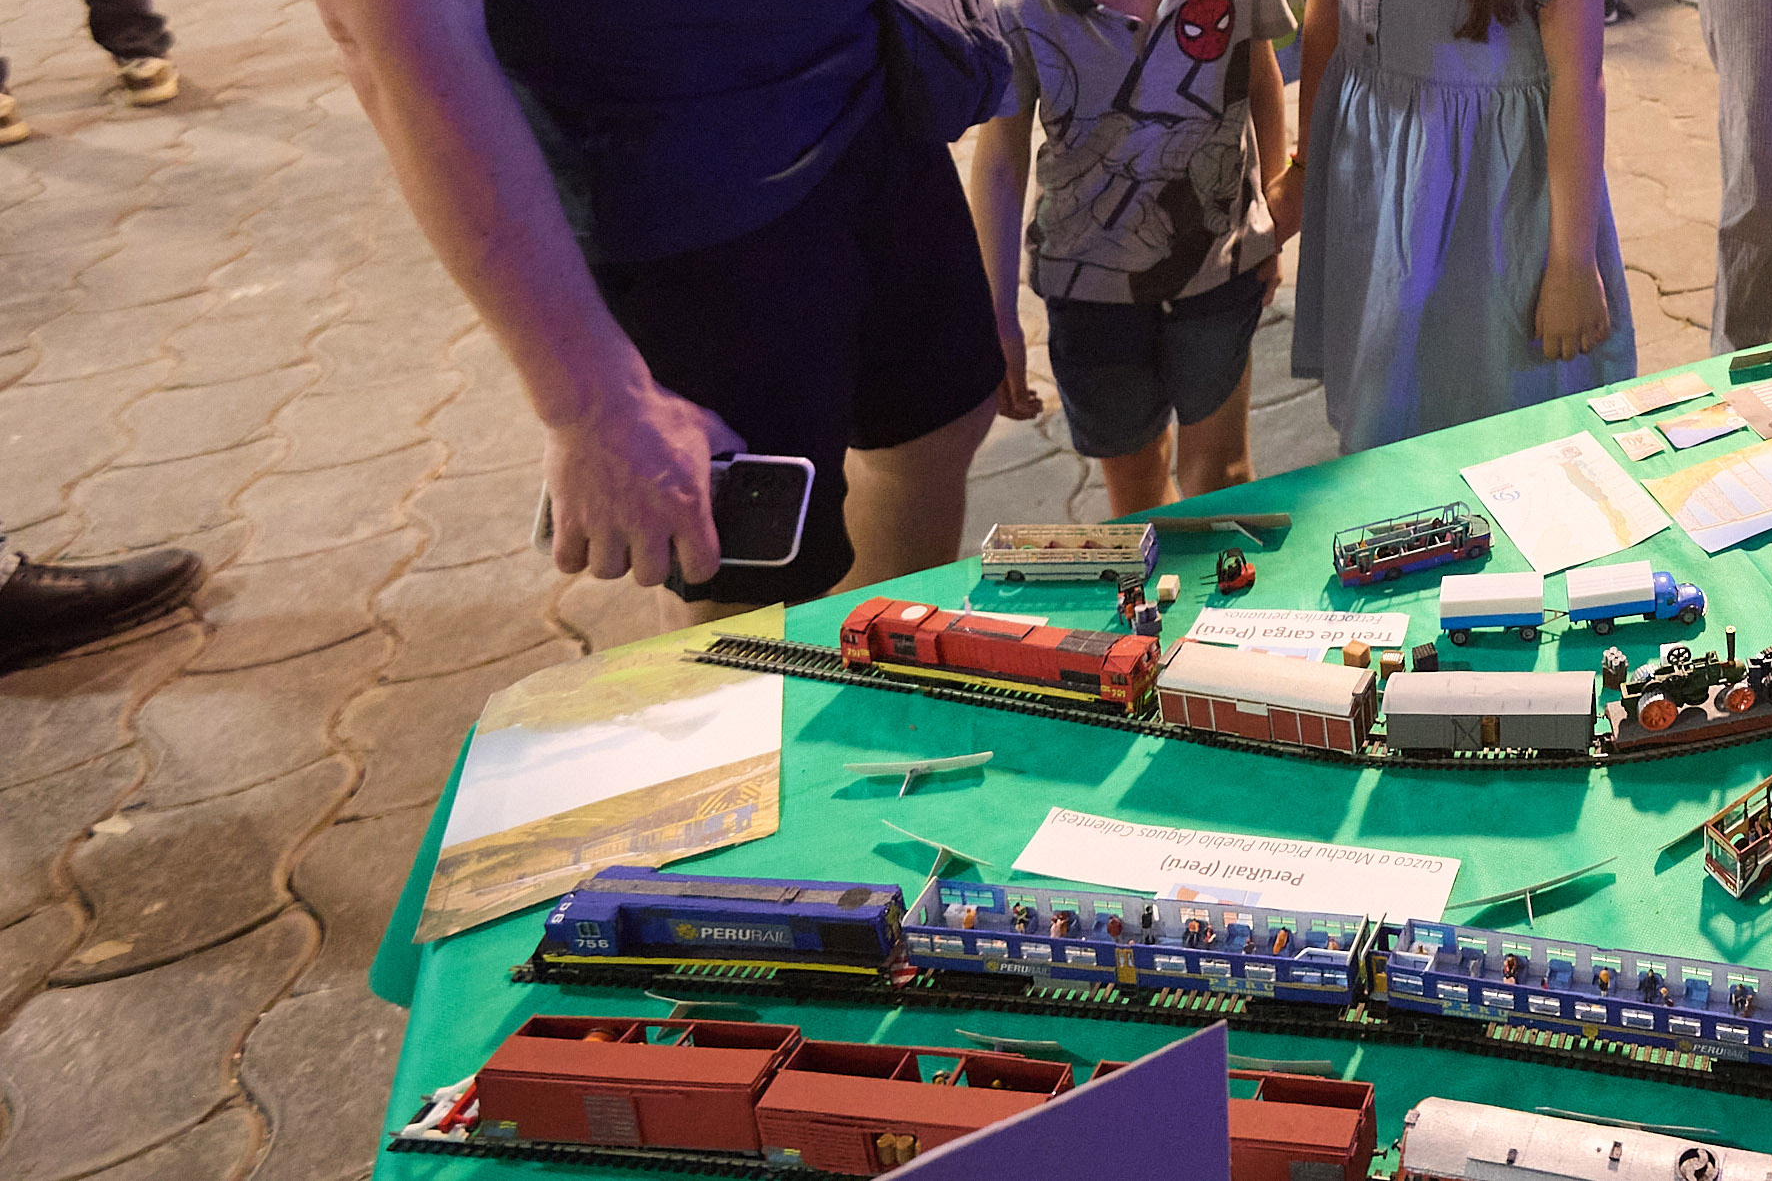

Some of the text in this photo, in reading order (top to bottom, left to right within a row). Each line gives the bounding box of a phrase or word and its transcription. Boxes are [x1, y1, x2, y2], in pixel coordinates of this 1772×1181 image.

[1224, 611, 1292, 621] peruanos
[1195, 622, 1394, 643] Tren de carga (Perú)
[1051, 807, 1443, 874] Cuzco a Machu Picchu Pueblo (Aguas Calientes)
[1161, 854, 1305, 886] PerúRail (Perú)
[575, 938, 610, 949] 756
[700, 925, 790, 945] PERURAIL
[1692, 1043, 1749, 1061] PERURAIL
